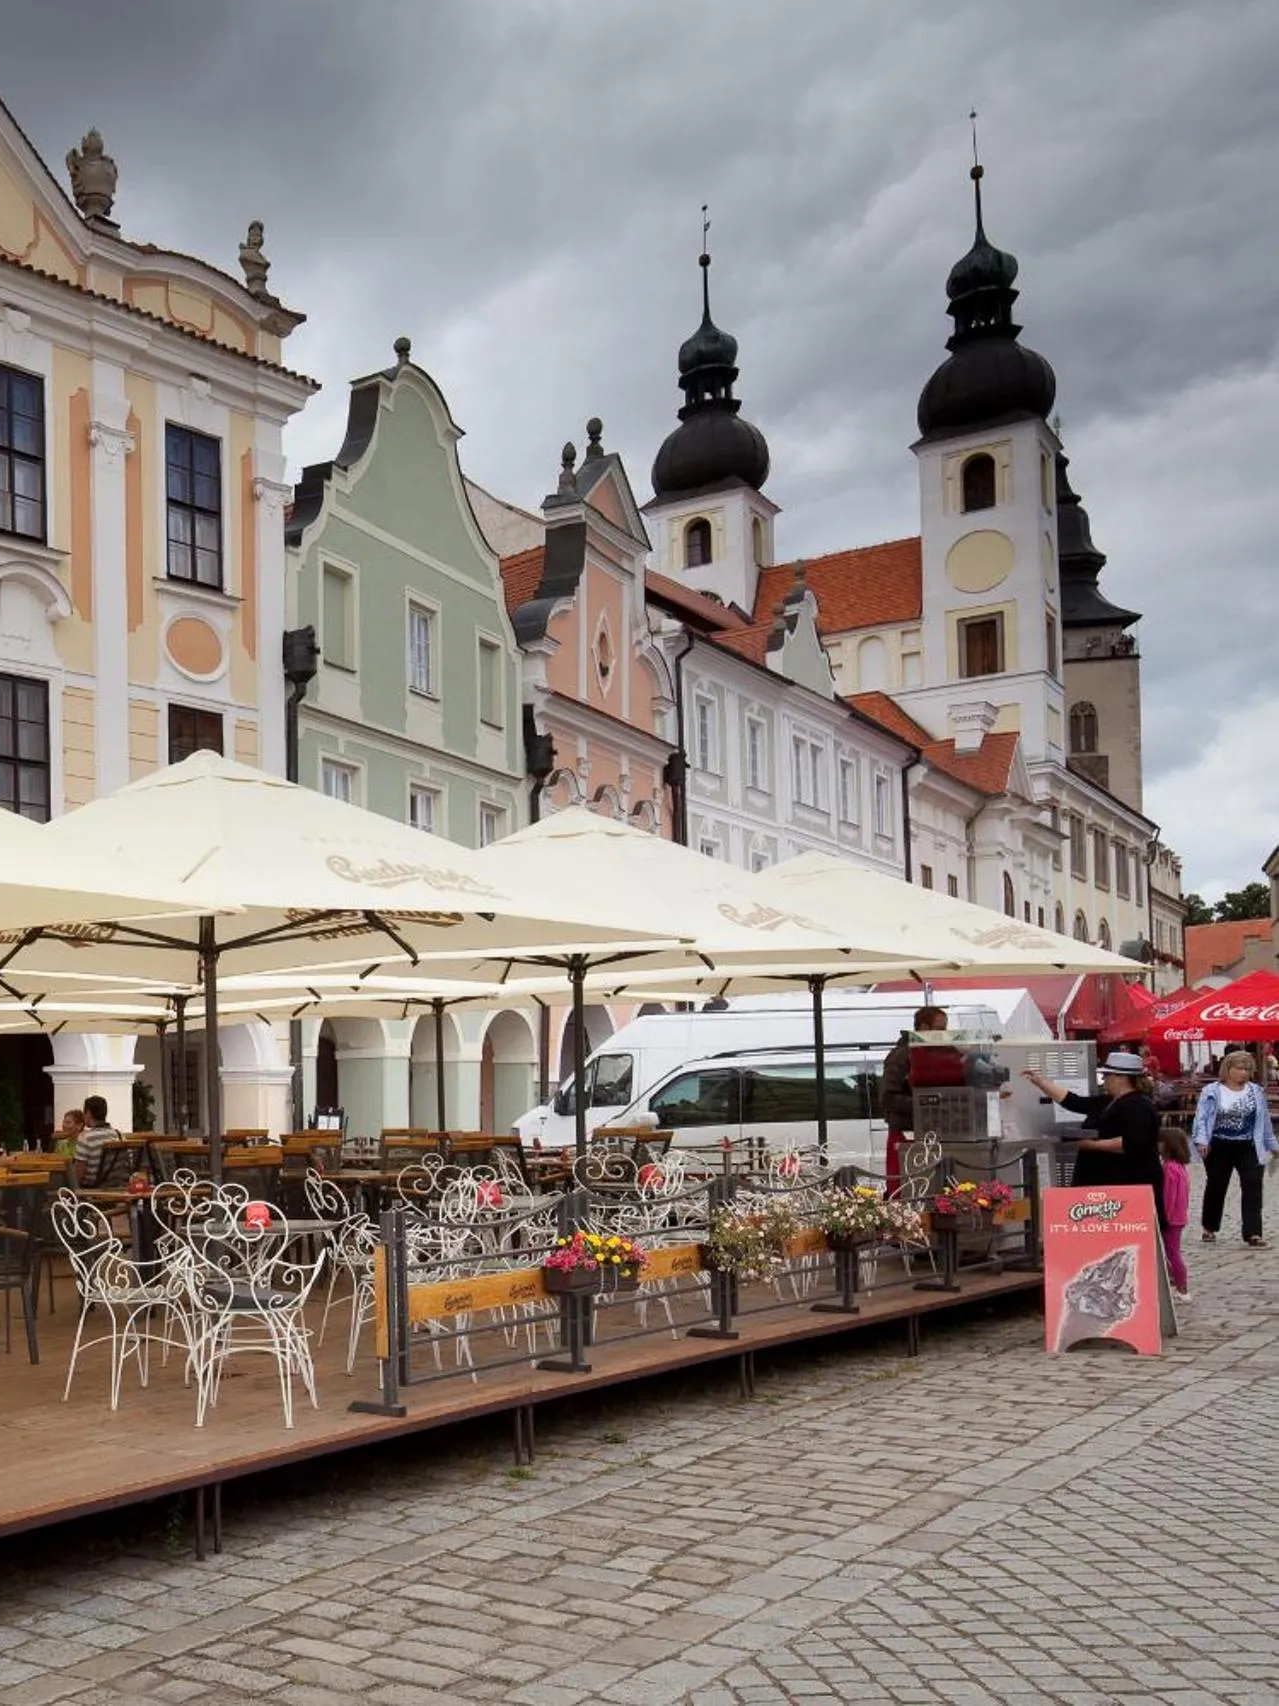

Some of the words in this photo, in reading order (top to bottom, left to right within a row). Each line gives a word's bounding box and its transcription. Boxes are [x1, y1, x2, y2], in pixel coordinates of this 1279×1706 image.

[1072, 1223, 1079, 1233] A
[1081, 1223, 1110, 1233] LOVE
[1114, 1222, 1148, 1233] THING
